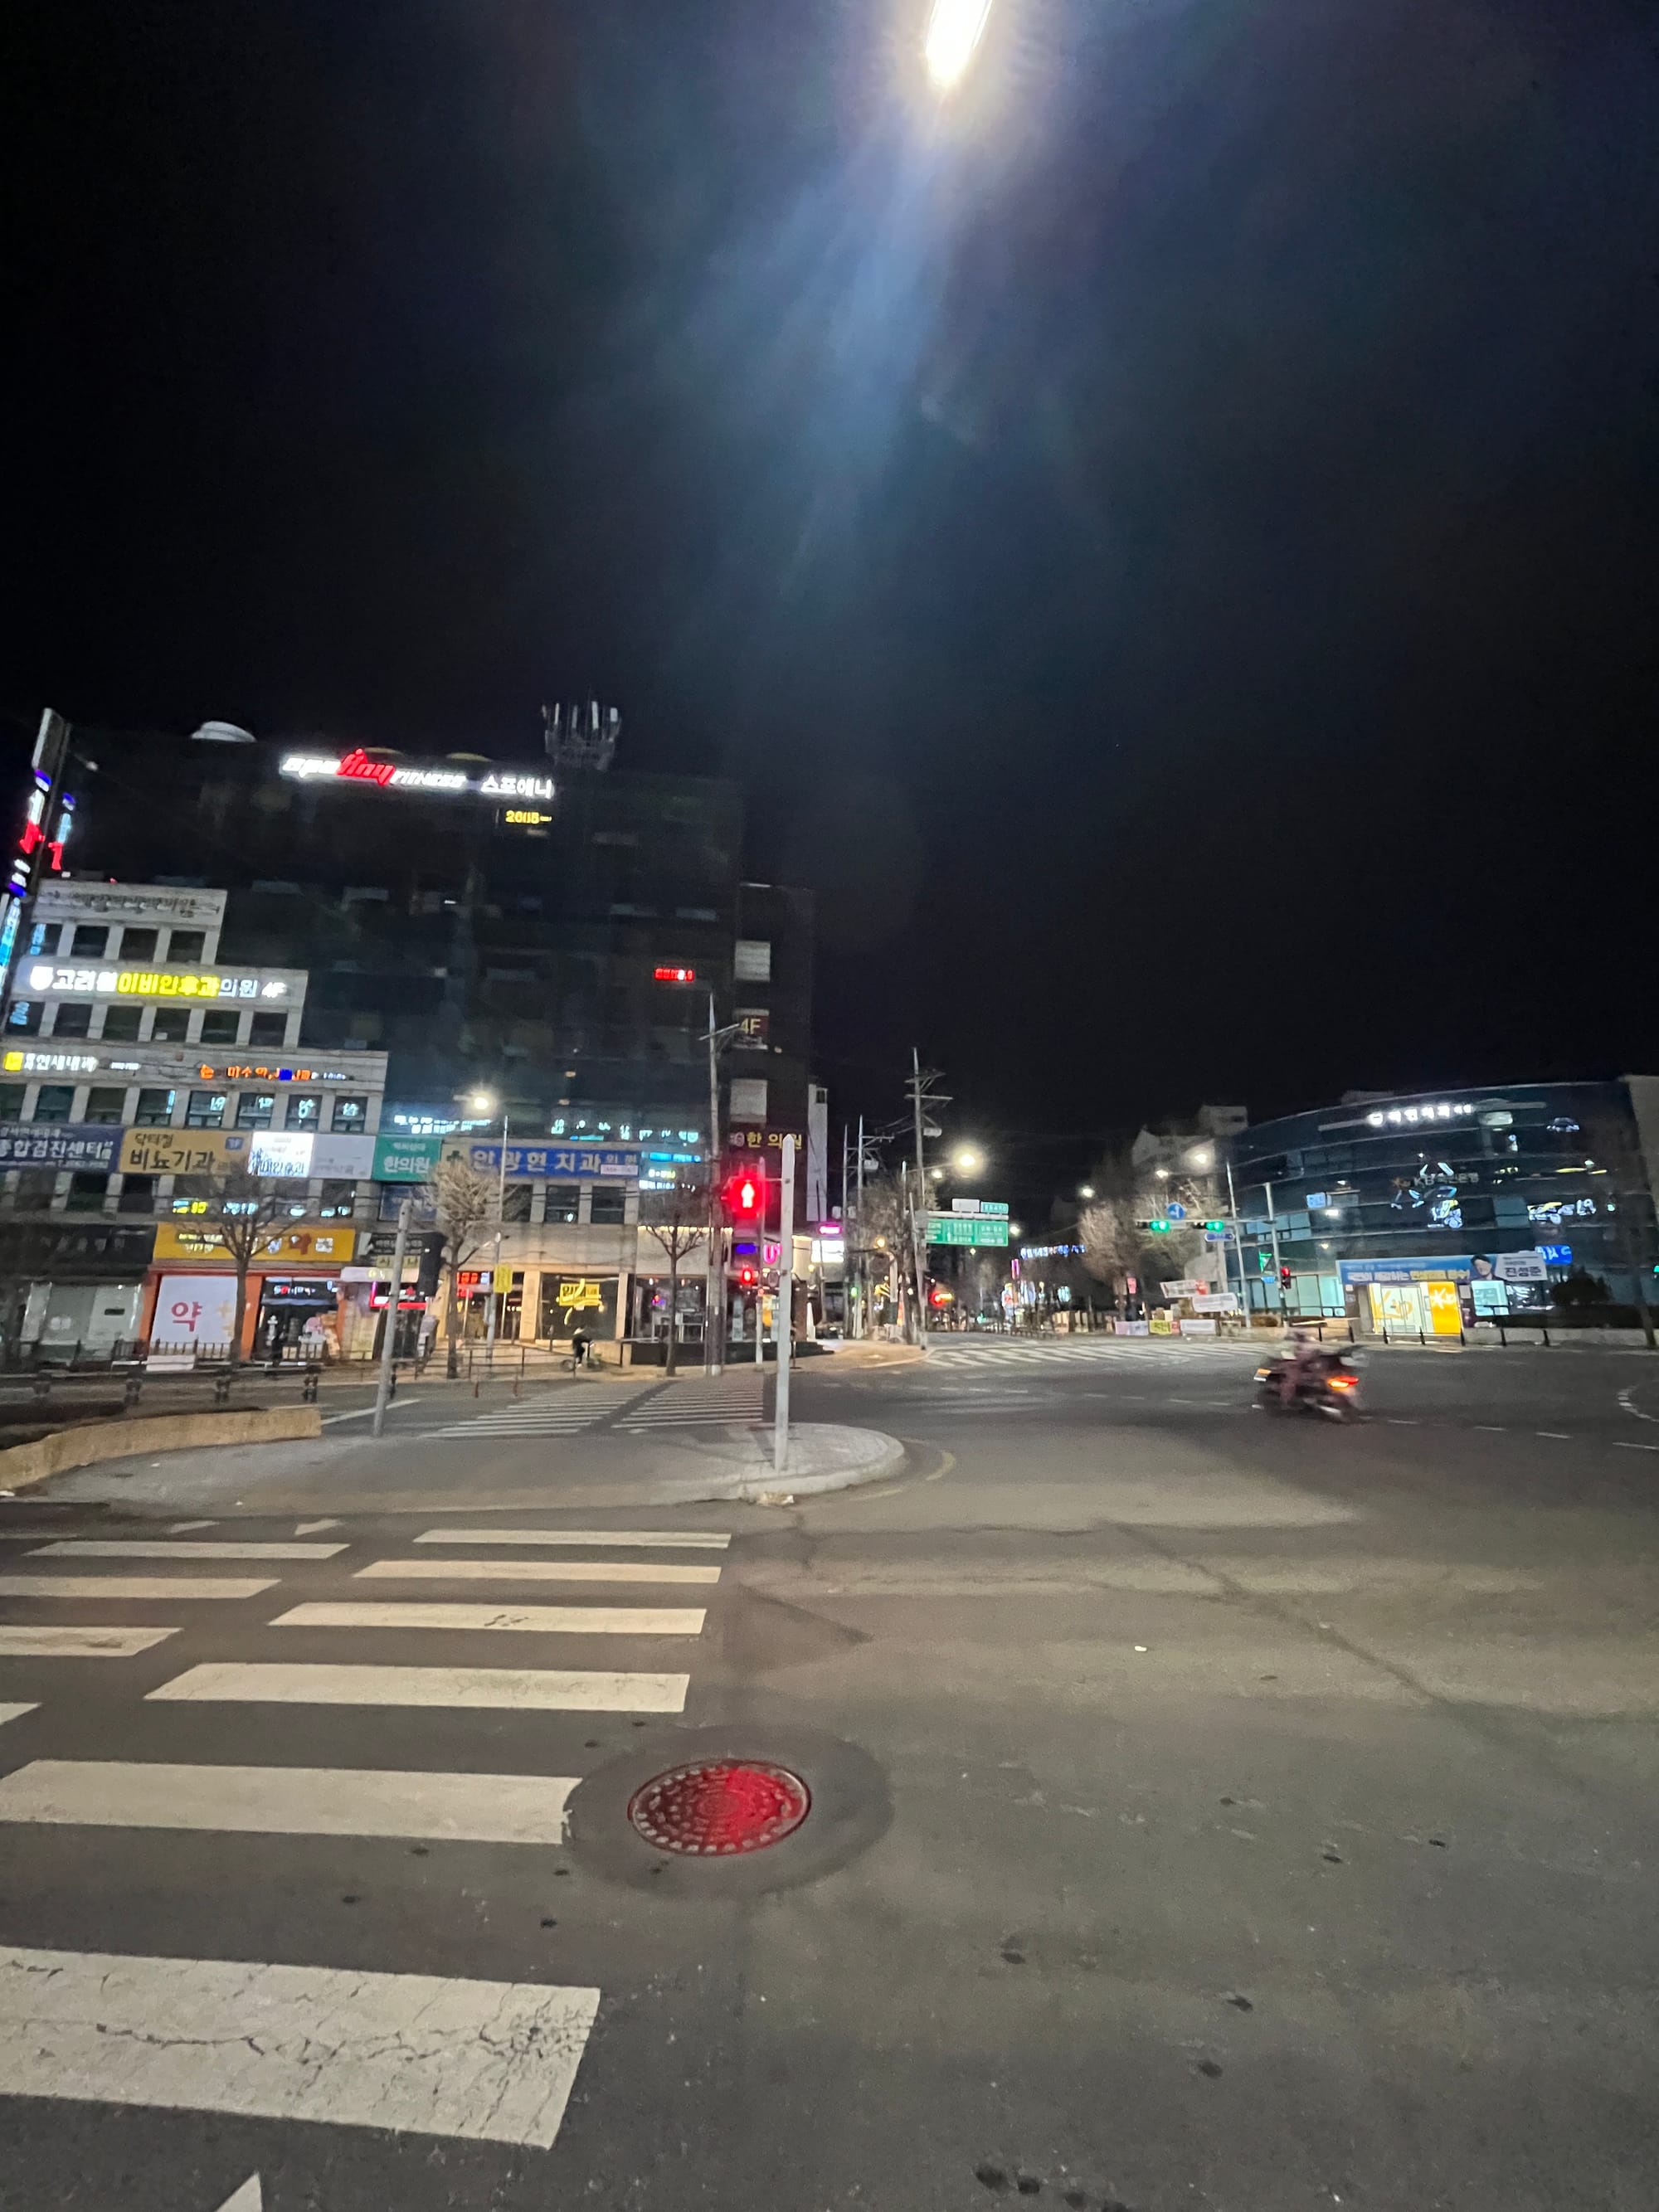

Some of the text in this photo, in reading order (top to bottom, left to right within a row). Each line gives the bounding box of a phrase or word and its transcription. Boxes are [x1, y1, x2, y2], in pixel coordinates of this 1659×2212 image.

[481, 775, 554, 800] 스포애니
[740, 1018, 761, 1034] 4F
[130, 1149, 216, 1171] 비뇨기과
[384, 1155, 431, 1174] 한의원
[171, 1301, 202, 1332] 약
